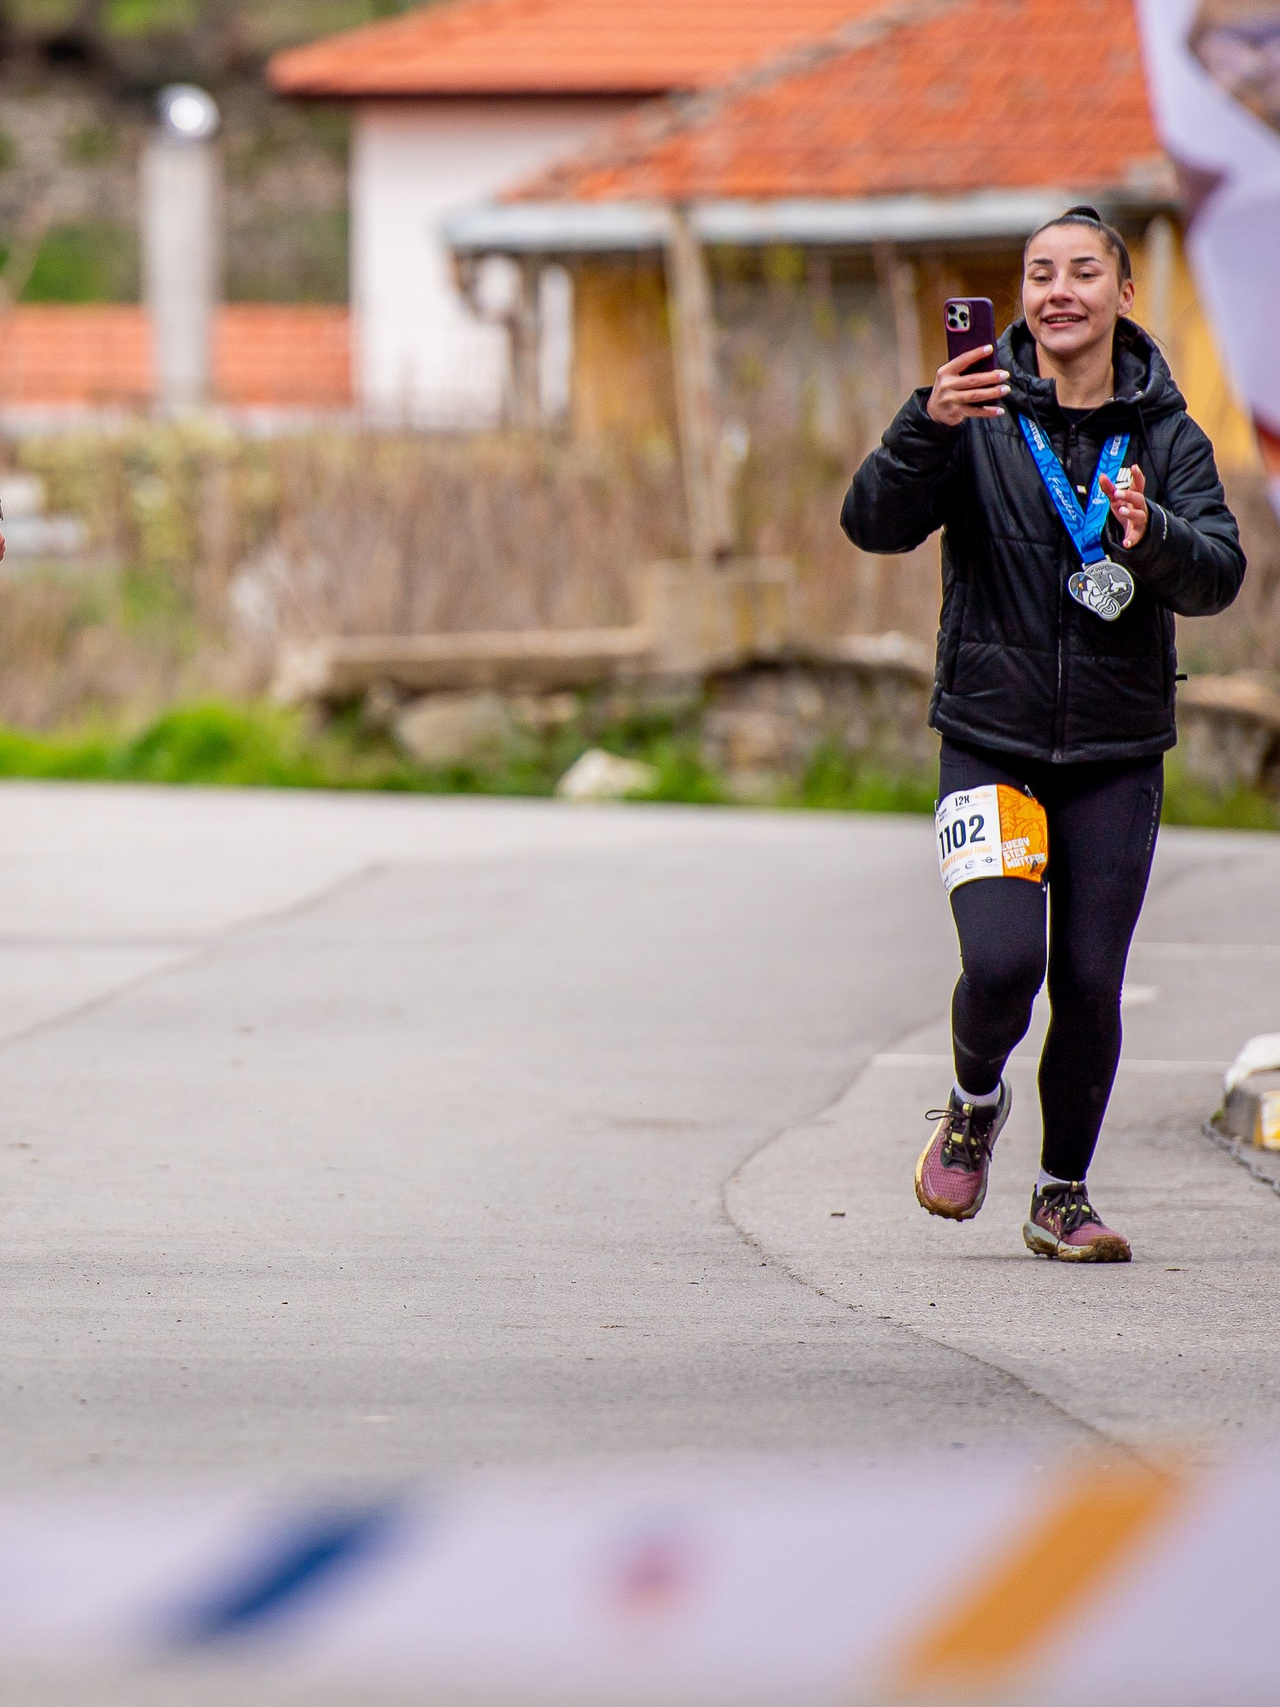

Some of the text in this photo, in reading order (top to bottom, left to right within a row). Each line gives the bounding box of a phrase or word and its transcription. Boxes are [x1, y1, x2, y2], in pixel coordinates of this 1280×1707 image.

[939, 814, 986, 860] 1102
[1001, 836, 1030, 851] EVERY
[1002, 847, 1027, 861] STEP
